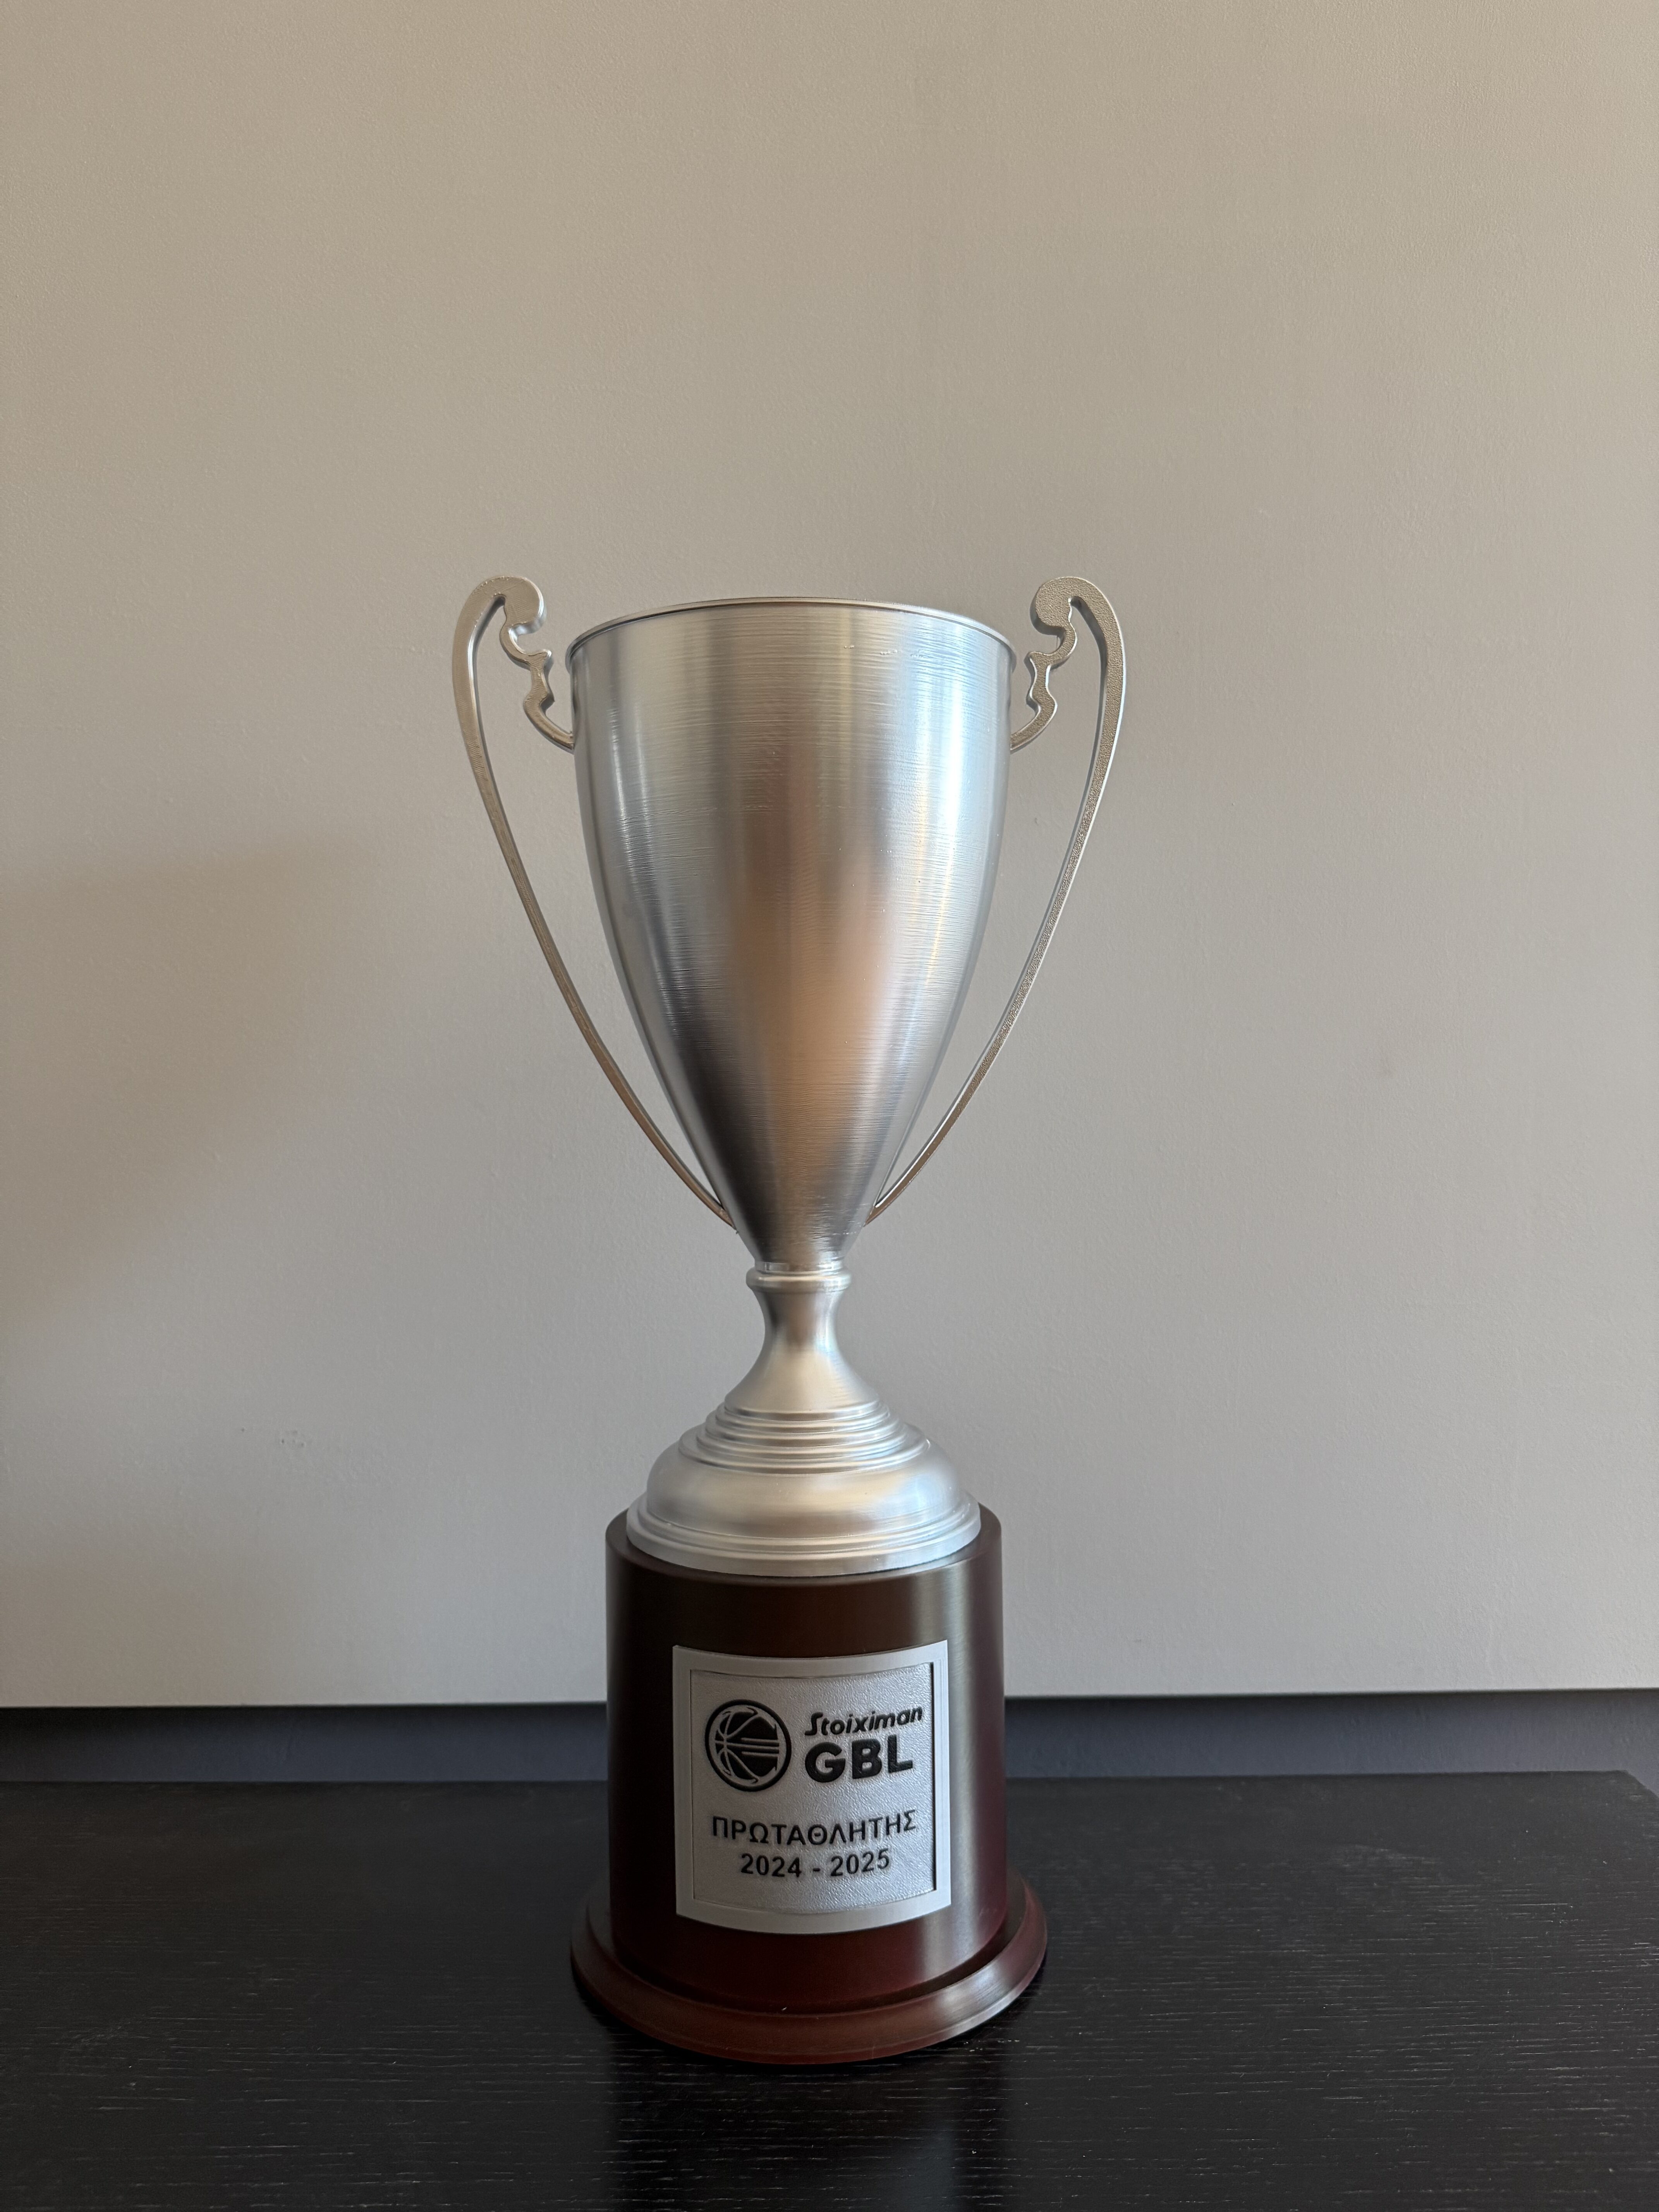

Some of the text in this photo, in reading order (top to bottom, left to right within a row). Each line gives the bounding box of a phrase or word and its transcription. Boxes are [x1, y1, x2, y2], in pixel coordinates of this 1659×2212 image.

[805, 1707, 922, 1736] Stoiximan
[805, 1735, 913, 1783] GBL
[713, 1810, 916, 1845] ΠΡΩΤΑΘΛΗΤΗΣ
[740, 1853, 801, 1877] 2024
[830, 1848, 890, 1877] 2025
